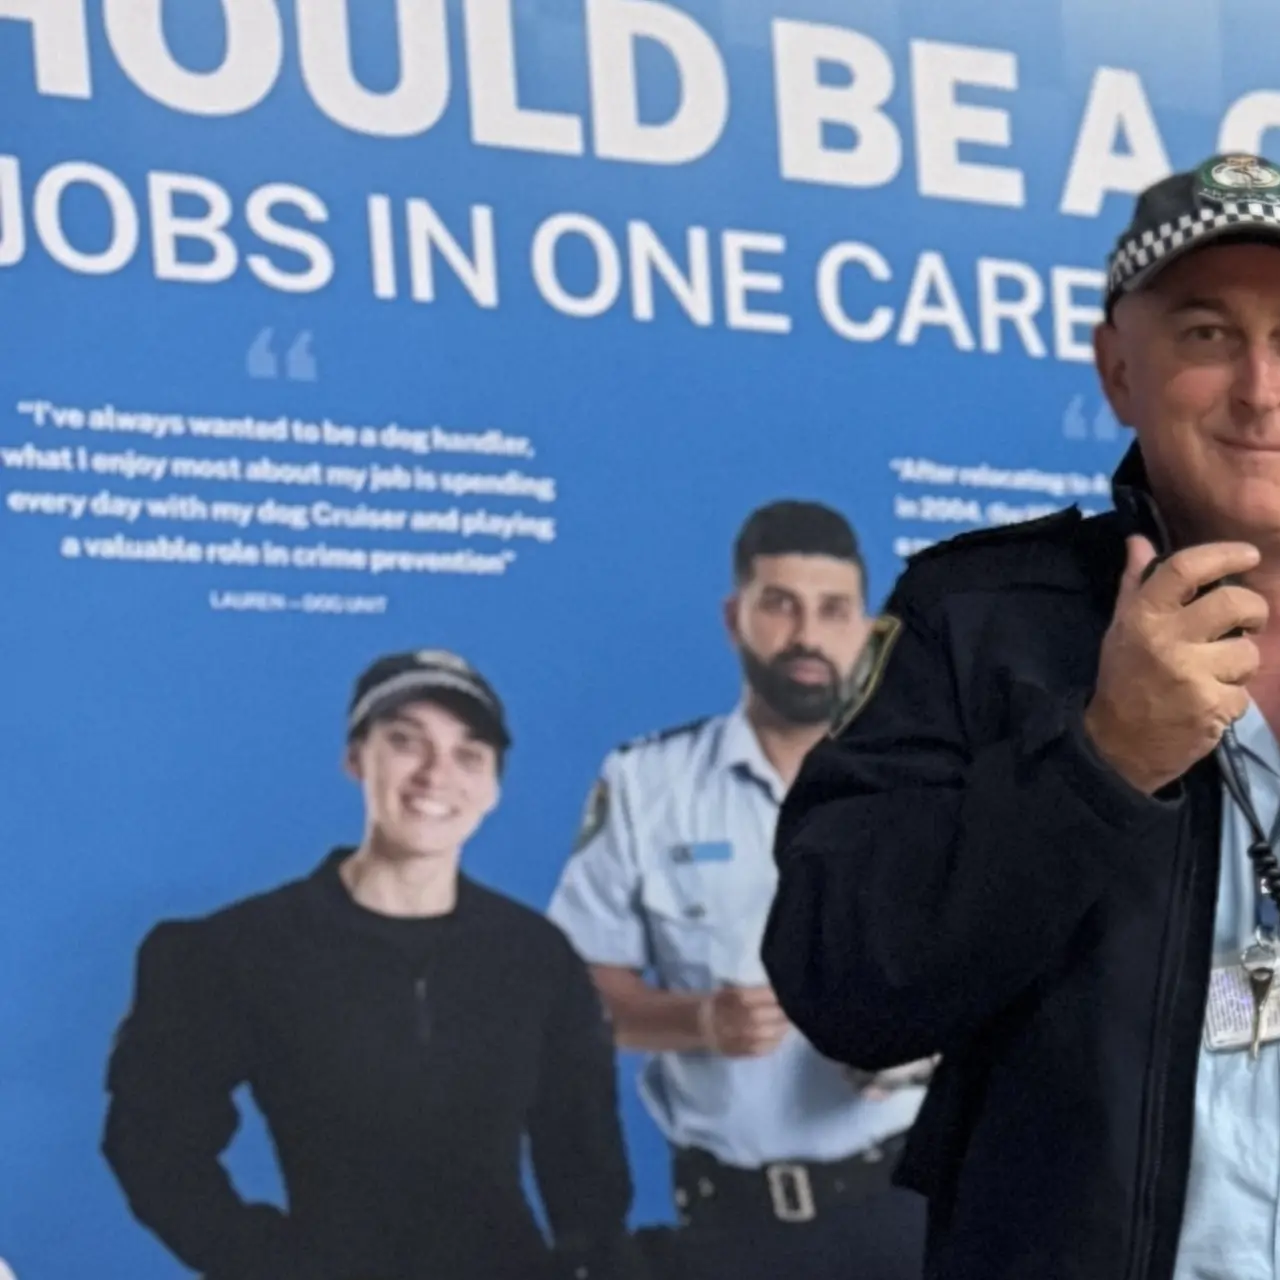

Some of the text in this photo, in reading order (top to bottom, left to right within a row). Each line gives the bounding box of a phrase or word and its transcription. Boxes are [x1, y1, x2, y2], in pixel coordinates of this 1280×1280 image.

[771, 18, 1025, 208] BE
[1060, 67, 1174, 217] A
[0, 153, 333, 294] JOBS
[368, 193, 499, 309] IN
[531, 212, 792, 334] ONE
[88, 403, 186, 439] always
[187, 415, 290, 442] wanted
[292, 419, 321, 444] to
[323, 418, 357, 447] be
[359, 426, 377, 447] a
[379, 422, 430, 455] dog
[0, 441, 73, 472] what
[90, 448, 168, 482] enjoy
[170, 457, 241, 481] most
[245, 456, 322, 486] about
[325, 465, 367, 493] my
[369, 461, 412, 494] job
[414, 464, 437, 491] is
[440, 468, 556, 503] spending
[6, 488, 556, 544] every day with my dog Cruiser and playing
[60, 535, 81, 559] a
[83, 531, 204, 565] valuable
[205, 538, 261, 566] role
[262, 539, 290, 567] in
[291, 540, 367, 571] crime
